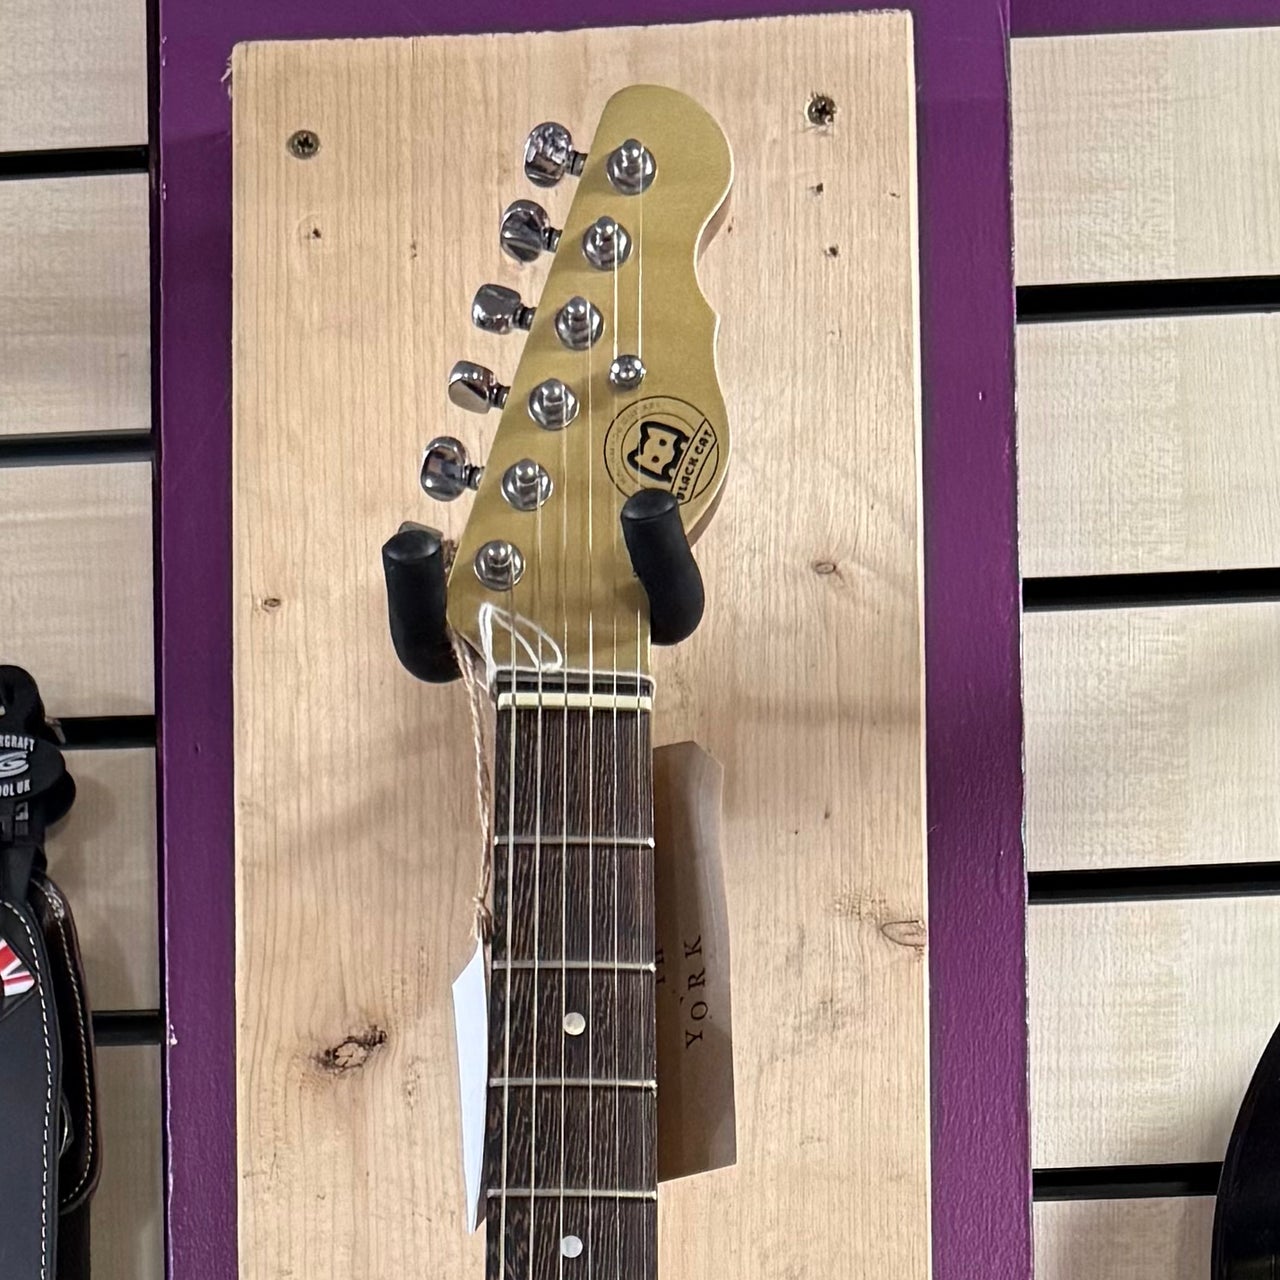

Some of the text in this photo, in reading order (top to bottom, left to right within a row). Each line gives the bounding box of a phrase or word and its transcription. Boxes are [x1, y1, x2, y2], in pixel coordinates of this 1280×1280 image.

[695, 429, 712, 455] CAT
[16, 779, 31, 795] UK
[683, 934, 710, 1049] YORK
